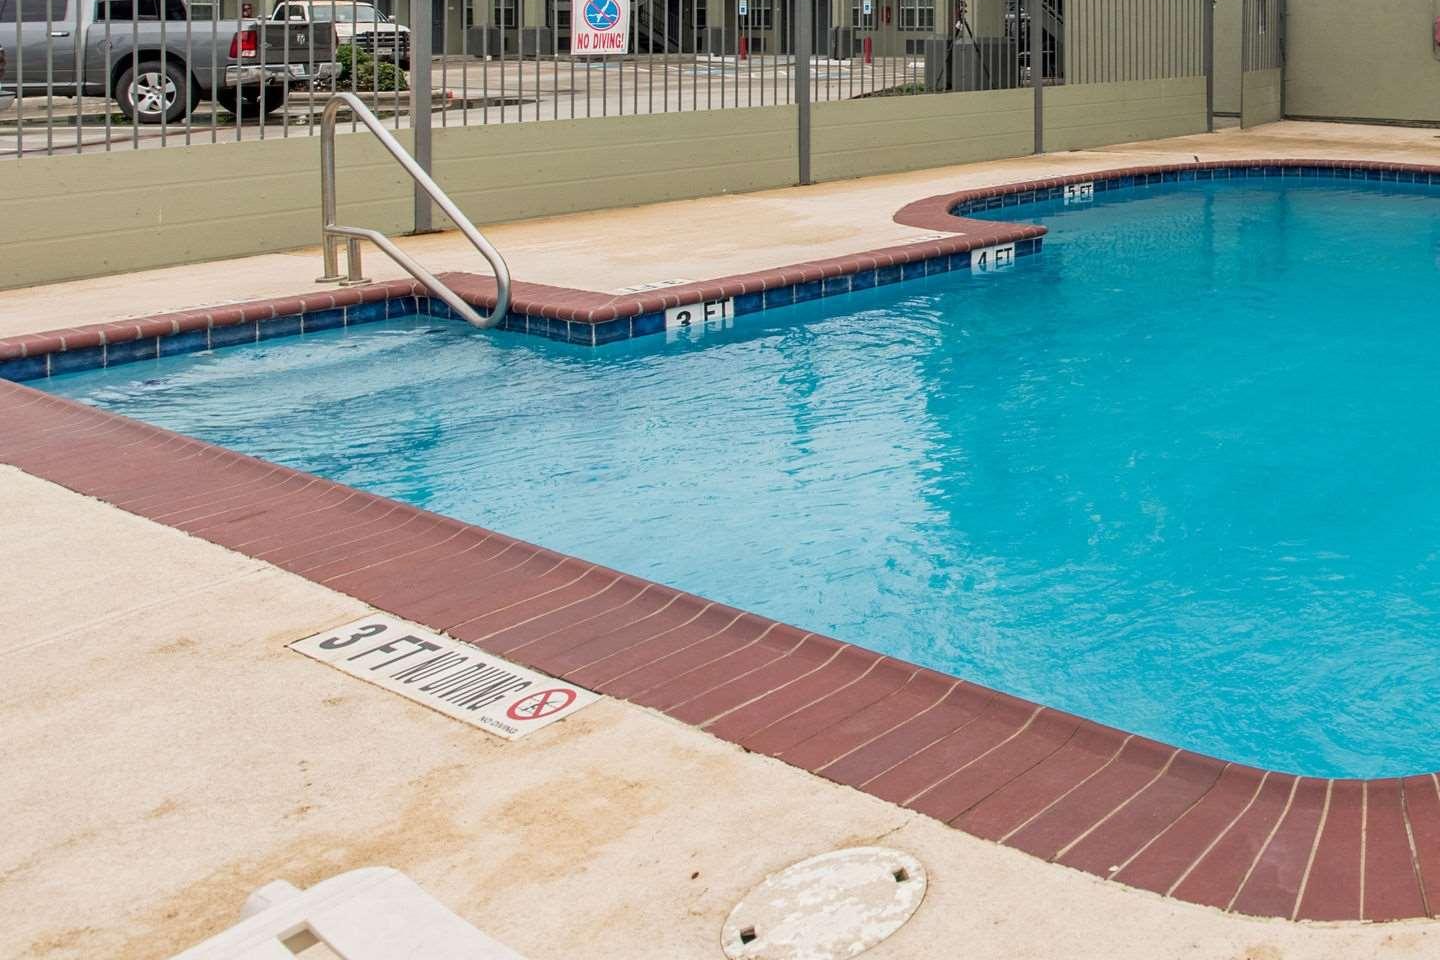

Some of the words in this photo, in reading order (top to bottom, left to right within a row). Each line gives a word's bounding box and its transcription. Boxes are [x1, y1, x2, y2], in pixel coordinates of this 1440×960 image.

[577, 32, 590, 50] NO
[592, 32, 624, 50] DIVING!
[1068, 185, 1075, 197] 5
[1080, 184, 1092, 201] FT
[995, 247, 1013, 264] FT
[675, 309, 692, 327] 3
[703, 296, 731, 323] FT
[318, 622, 389, 651] 3
[347, 634, 444, 671] FT
[389, 650, 467, 686] NO
[418, 662, 534, 712] DIVING
